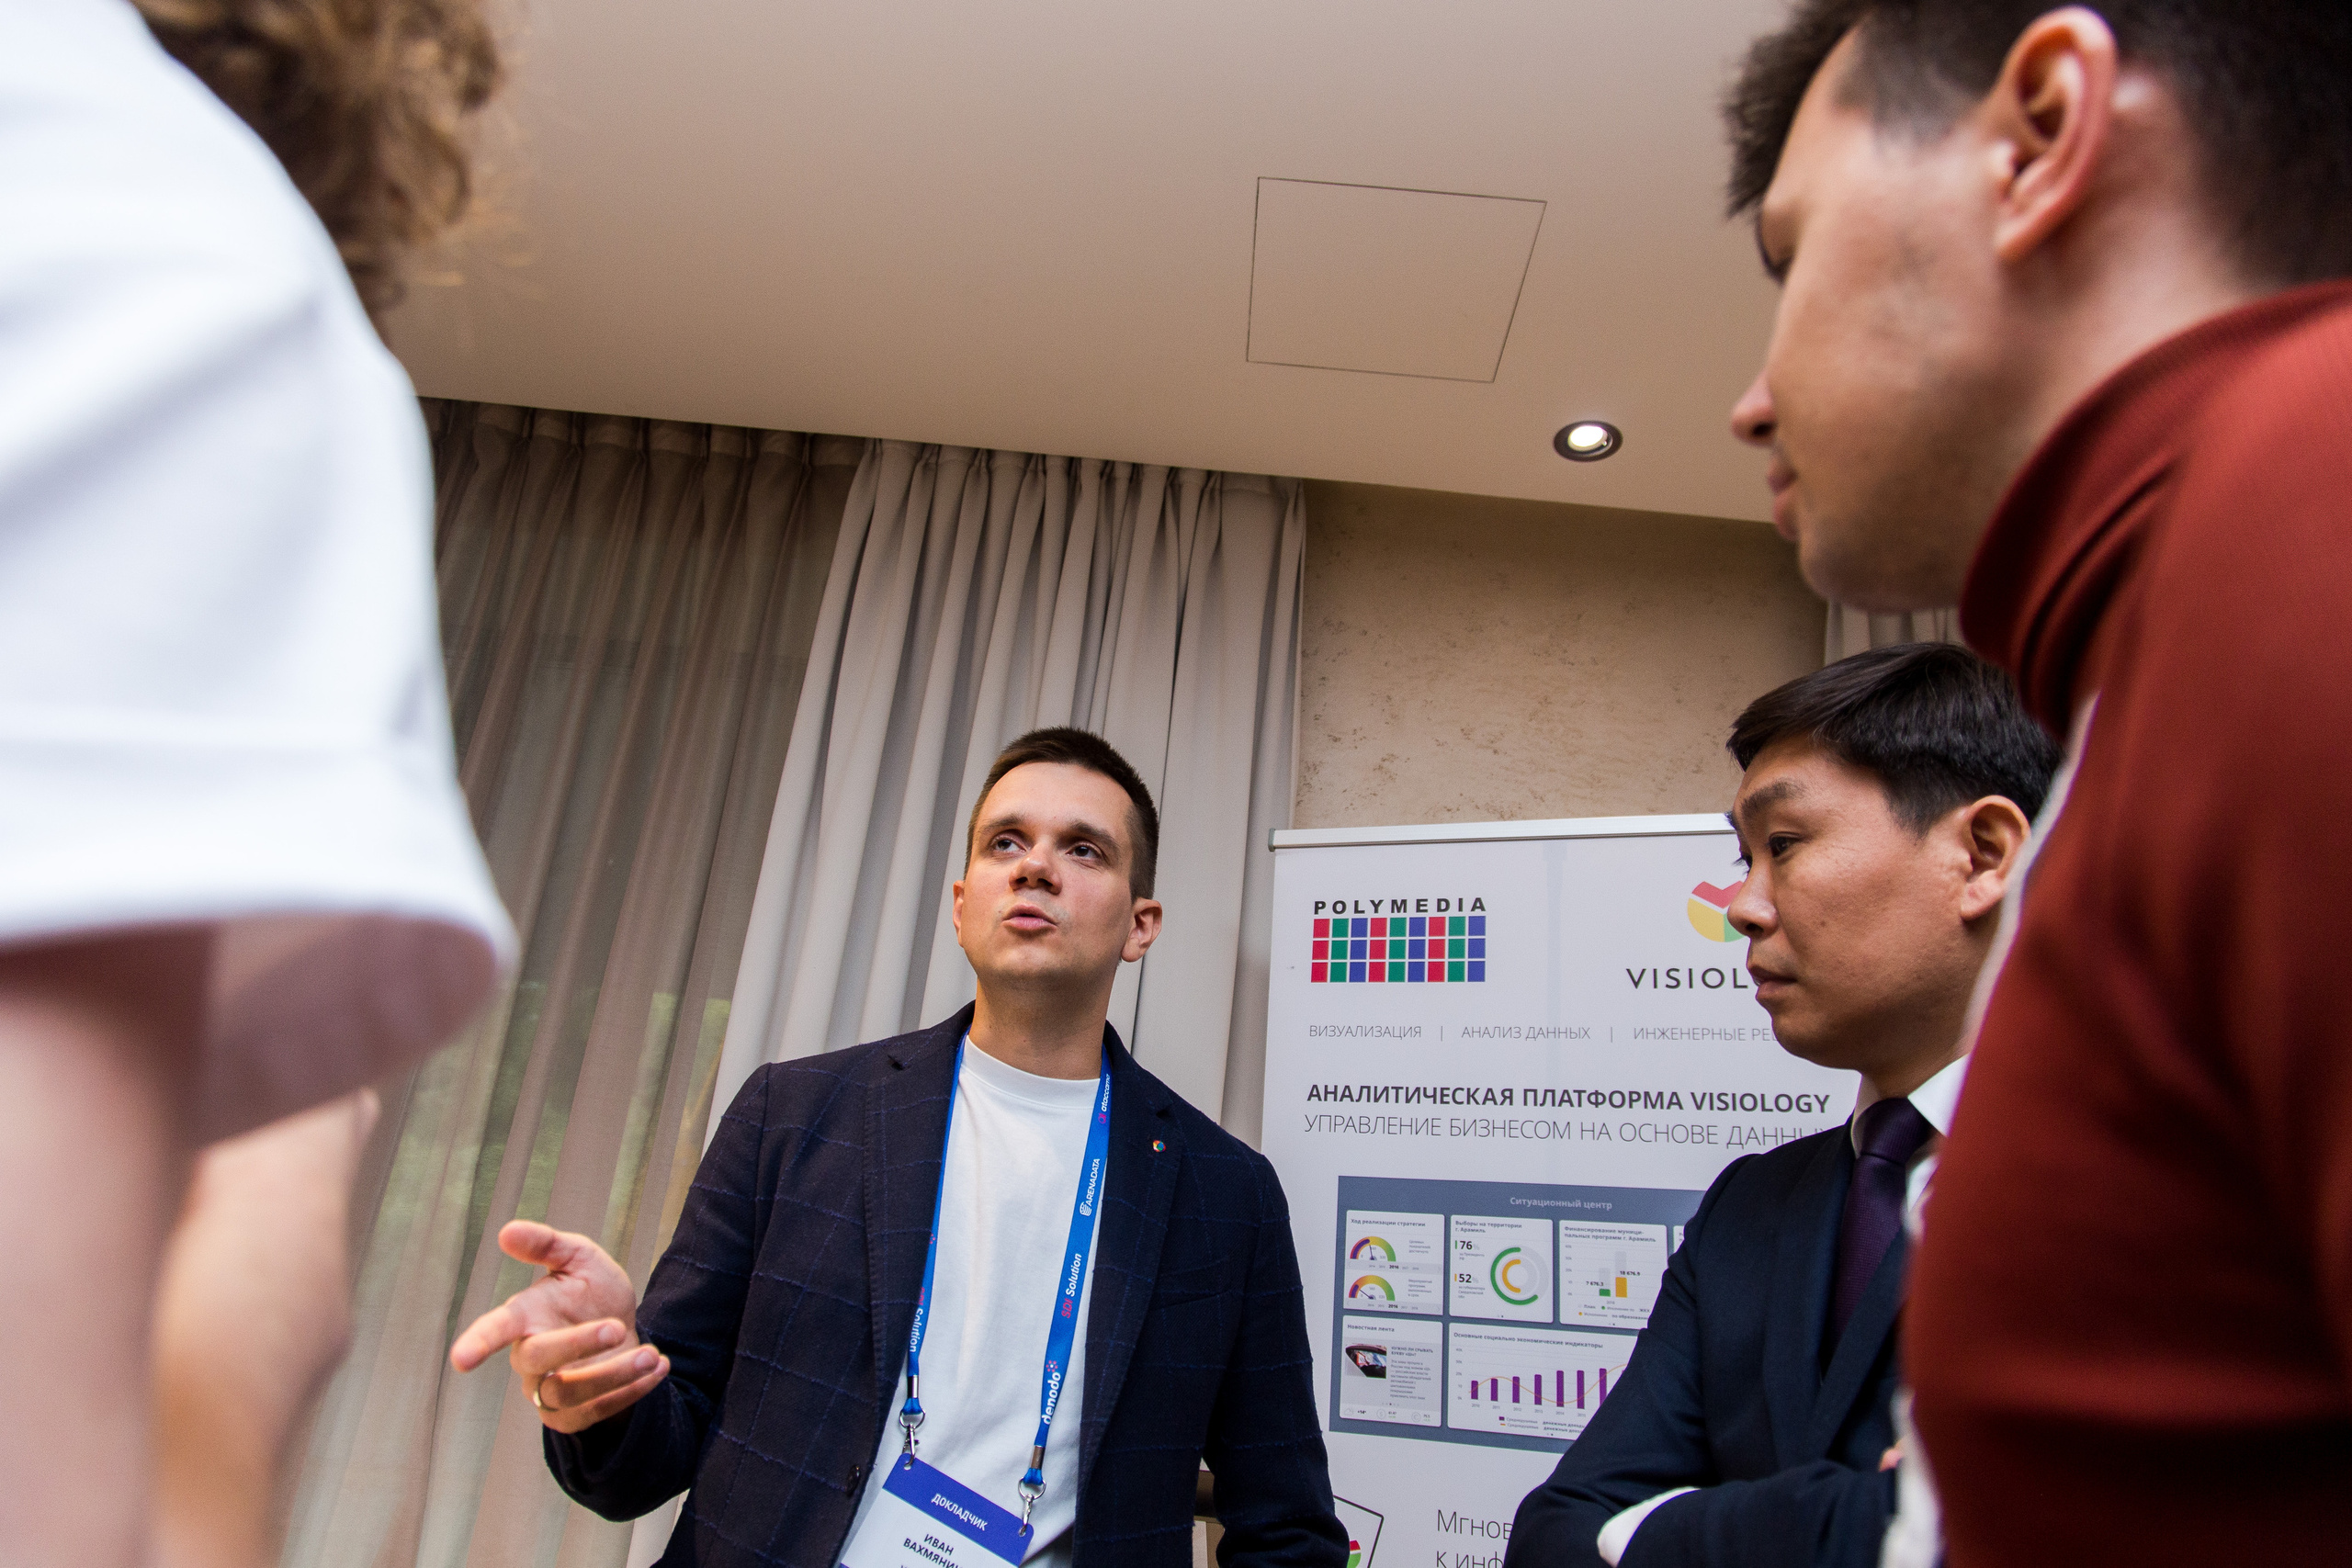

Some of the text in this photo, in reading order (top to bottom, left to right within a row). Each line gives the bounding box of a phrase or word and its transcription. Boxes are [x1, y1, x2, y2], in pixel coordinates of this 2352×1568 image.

[1314, 897, 1486, 915] POLYMEDIA
[1625, 967, 1748, 989] VISIOL
[1308, 1025, 1422, 1040] ВИЗУАЛИЗАЦИЯ
[1461, 1026, 1522, 1040] АНАЛИЗ
[1525, 1026, 1591, 1042] ДАННЫХ
[1634, 1027, 1747, 1042] ИНЖЕНЕРНЫЕ
[1306, 1084, 1830, 1113] АНАЛИТИЧЕСКАЯ ПЛАТФОРМА VISIOLOGY
[1304, 1114, 1824, 1149] УПРАВЛЕНИЕ БИЗНЕСОМ НА ОСНОВЕ ДАНН
[1085, 1158, 1101, 1207] ARENADATA
[1510, 1197, 1612, 1212] Ситуационный центр
[1061, 1253, 1082, 1319] SDI Solution
[1453, 1332, 1483, 1340] Основные
[1516, 1337, 1564, 1346] экономические
[1042, 1372, 1061, 1425] denodo
[931, 1493, 988, 1531] ДОКЛАДЧИК
[923, 1533, 955, 1556] ИВАН
[1455, 1551, 1504, 1568] инф
